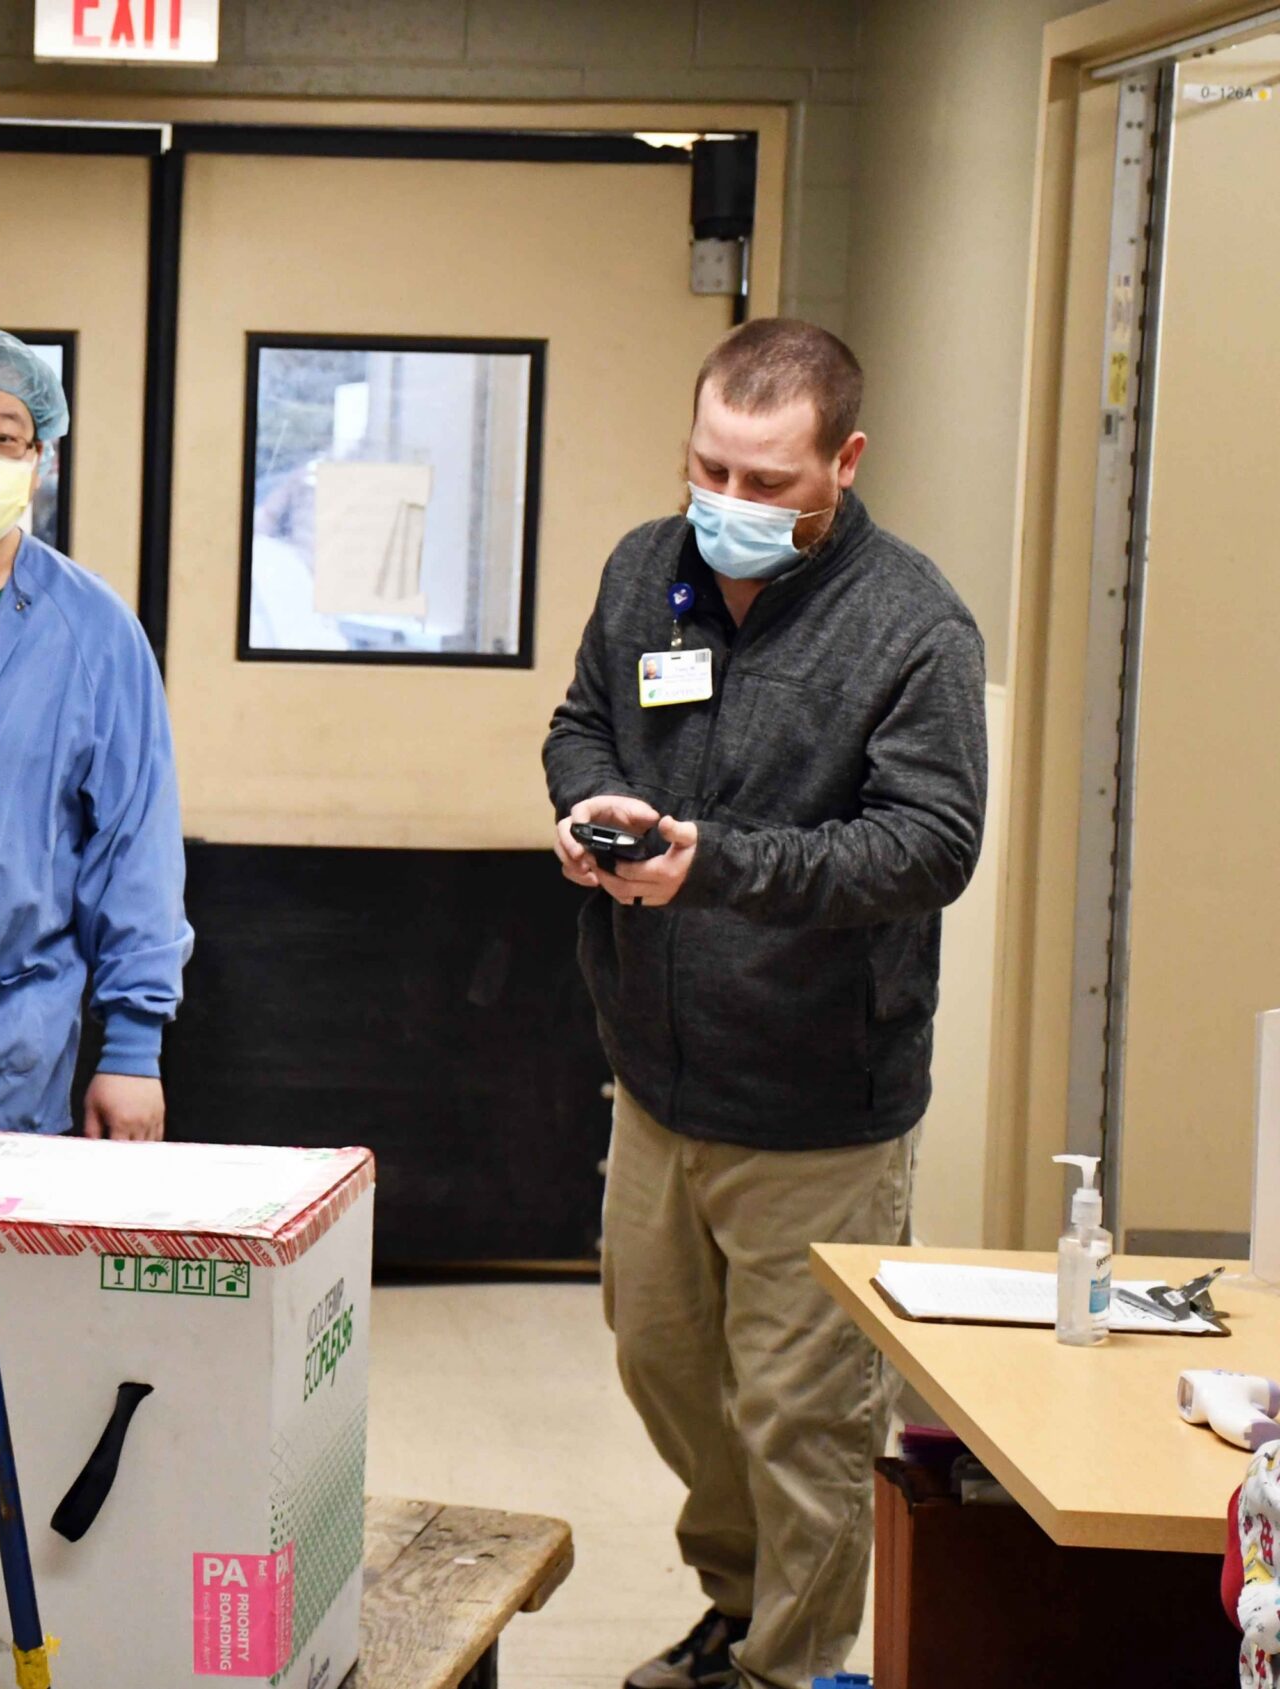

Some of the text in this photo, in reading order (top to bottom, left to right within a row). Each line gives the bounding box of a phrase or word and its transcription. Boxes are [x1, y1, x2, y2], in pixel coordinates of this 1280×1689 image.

[203, 1557, 248, 1588] PA
[219, 1592, 231, 1671] BOARDING
[237, 1593, 249, 1662] PRIORITY
